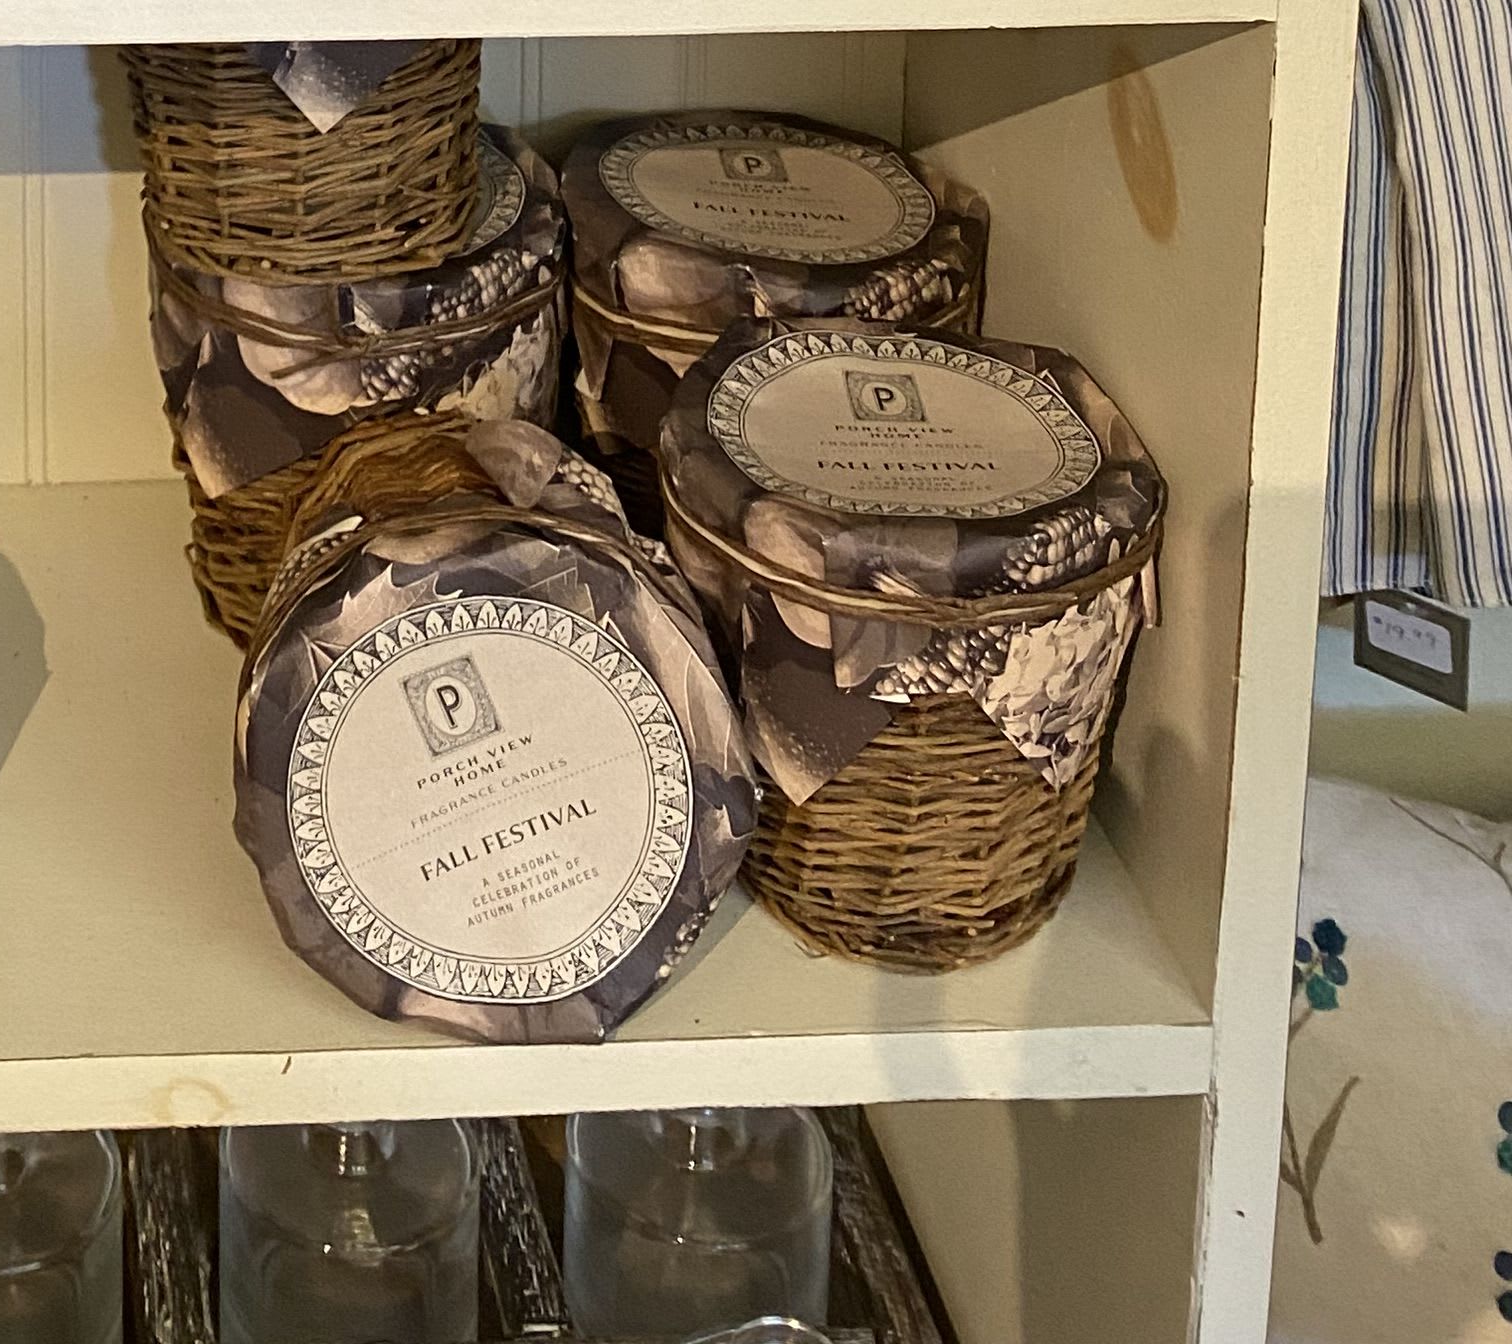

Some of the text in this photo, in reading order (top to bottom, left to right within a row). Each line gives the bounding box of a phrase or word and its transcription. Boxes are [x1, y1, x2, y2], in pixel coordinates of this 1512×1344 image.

[817, 459, 999, 472] FALL FESTIVAL
[435, 684, 462, 729] P
[416, 734, 533, 790] PORCH VIEW
[453, 758, 506, 787] HOME
[419, 798, 597, 882] FALL FESTIVAL
